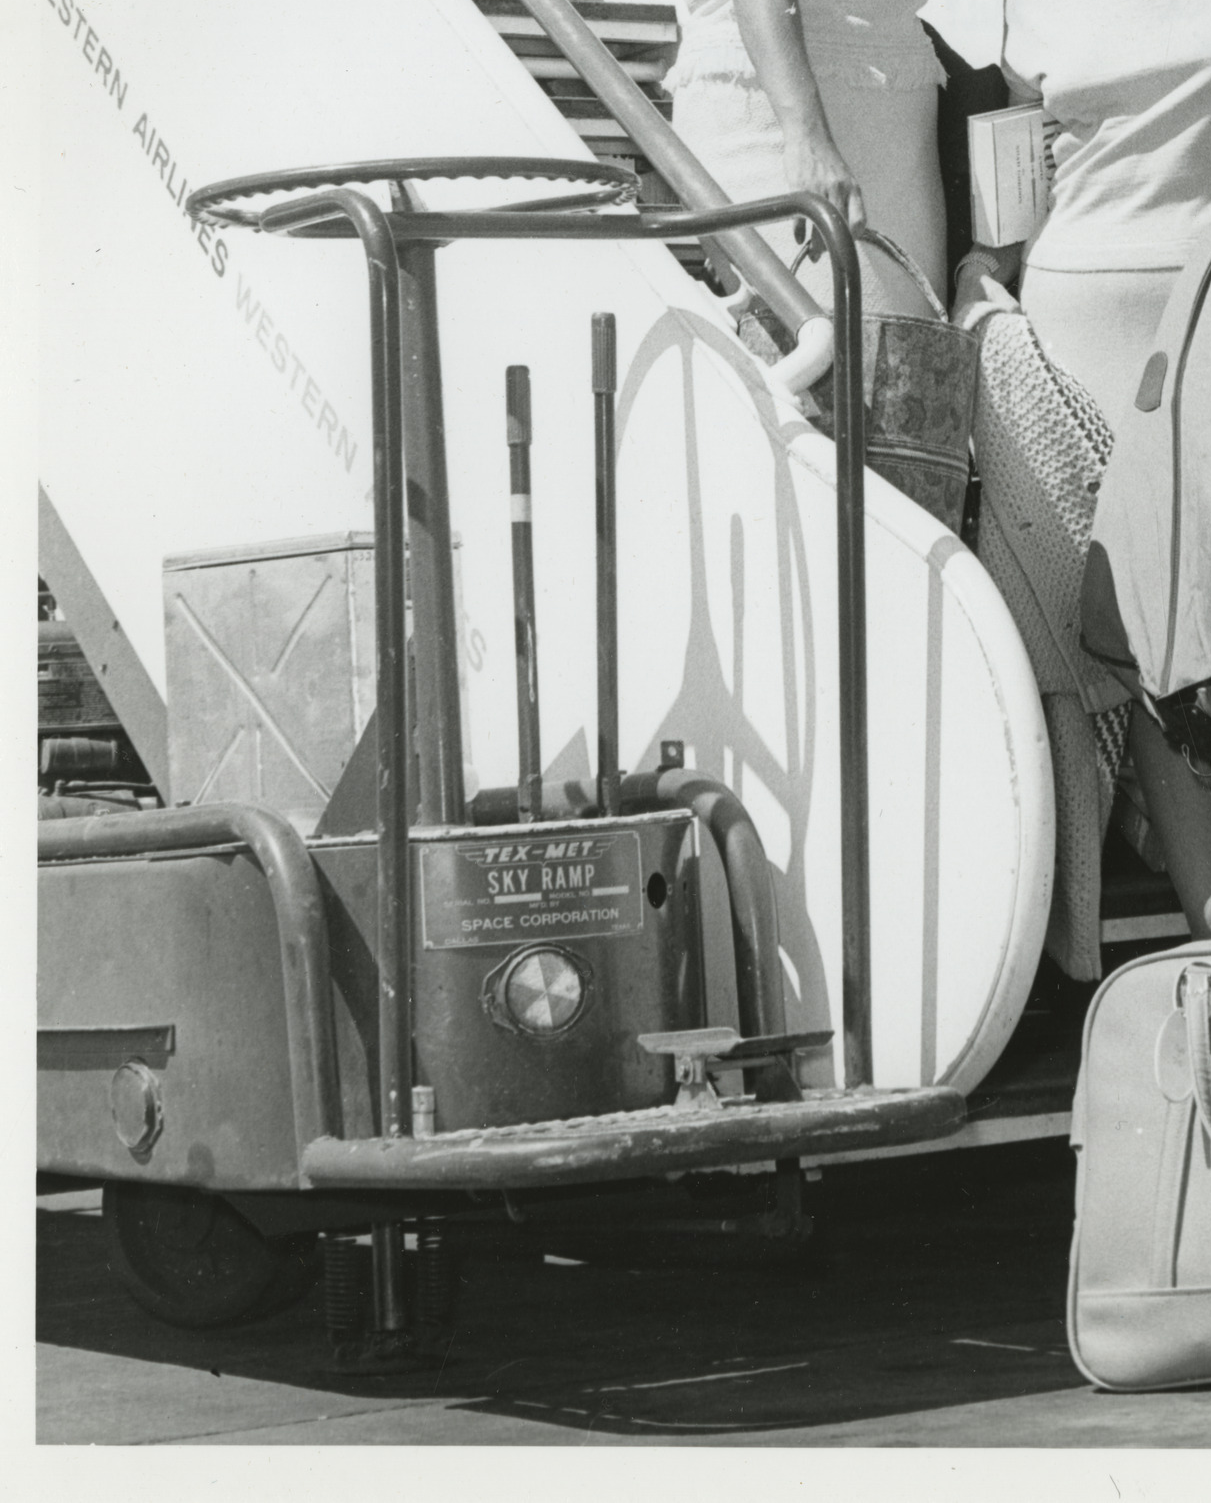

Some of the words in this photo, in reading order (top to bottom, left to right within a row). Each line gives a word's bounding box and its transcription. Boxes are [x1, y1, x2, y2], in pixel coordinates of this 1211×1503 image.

[234, 272, 359, 475] WESTERN
[484, 841, 594, 863] TEX-MET
[487, 868, 529, 894] SKY
[542, 864, 595, 890] RAMP
[461, 916, 514, 932] SPACE
[519, 908, 620, 927] CORPORATION
